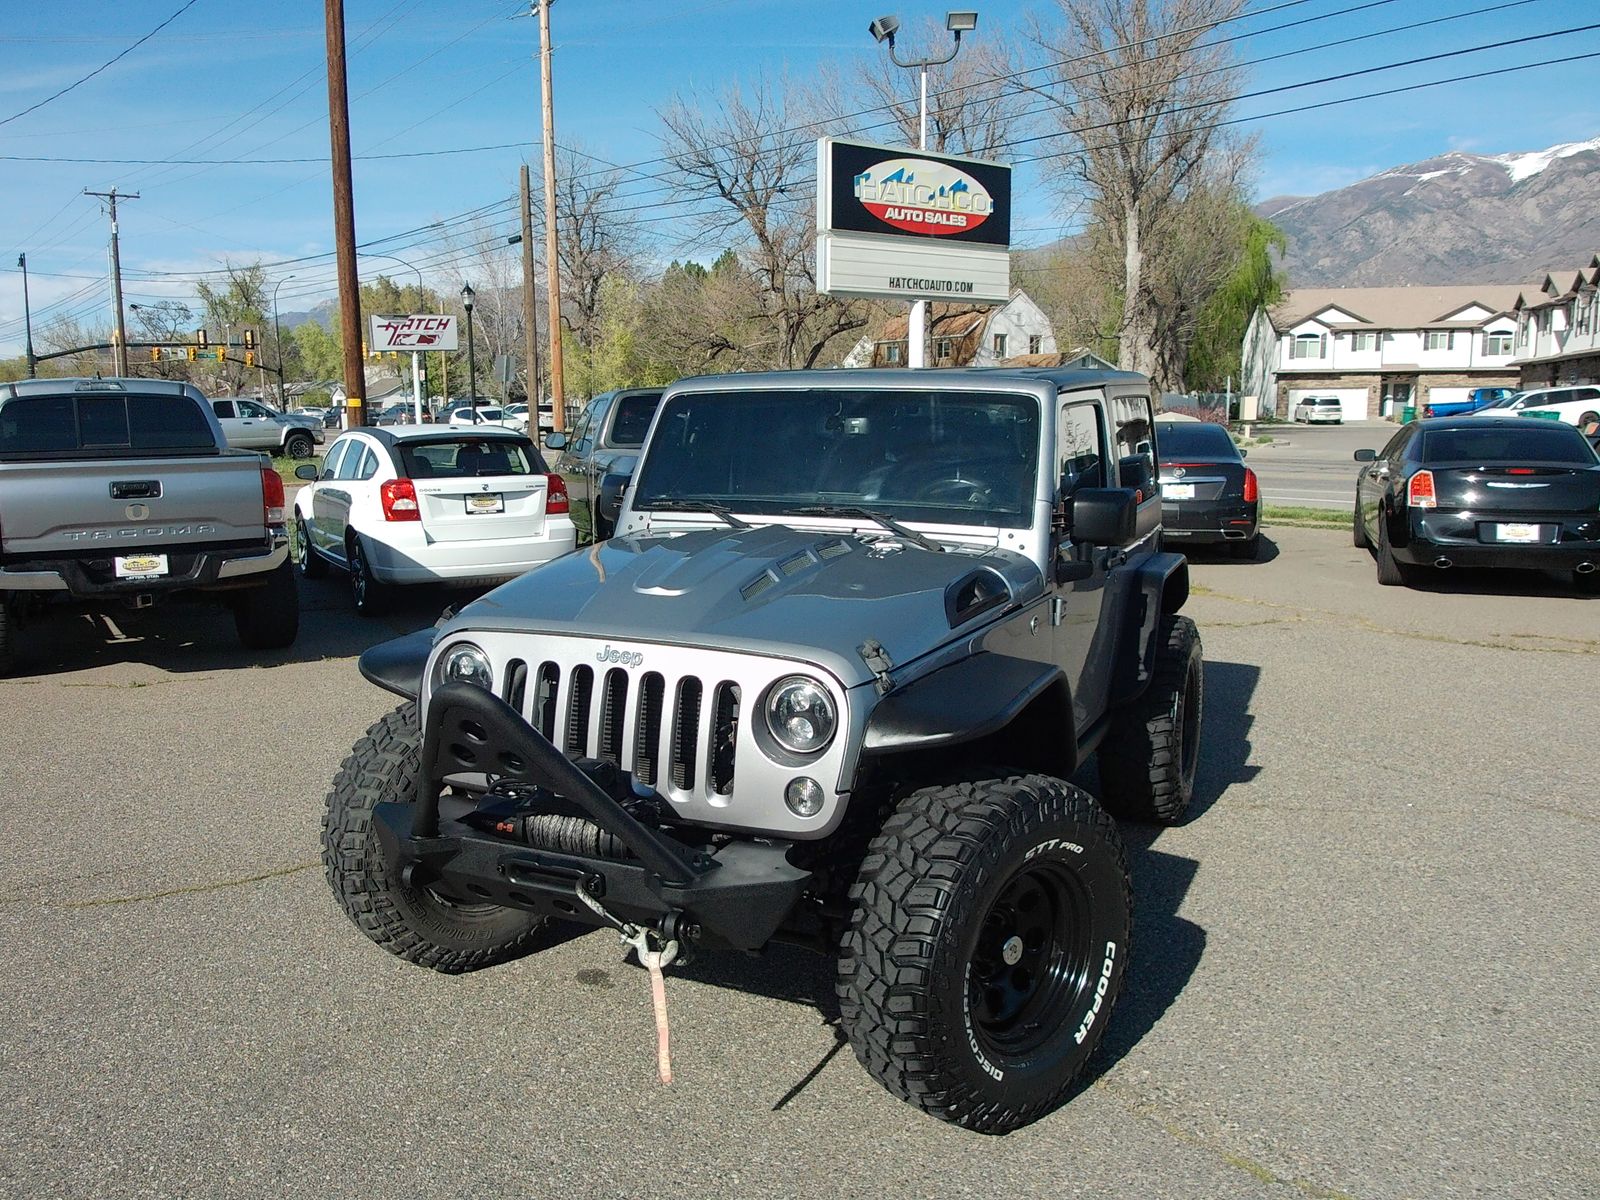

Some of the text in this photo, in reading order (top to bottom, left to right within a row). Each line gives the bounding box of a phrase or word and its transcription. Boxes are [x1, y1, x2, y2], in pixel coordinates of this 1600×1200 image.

[854, 174, 993, 213] HATCHCO
[885, 207, 967, 227] AUTO SALES
[889, 277, 973, 293] HATCHCOAUTO.COM
[62, 524, 215, 541] TACOMA
[596, 644, 644, 669] Jeep
[1024, 839, 1084, 862] STT PRO
[1073, 941, 1116, 1045] COOPER
